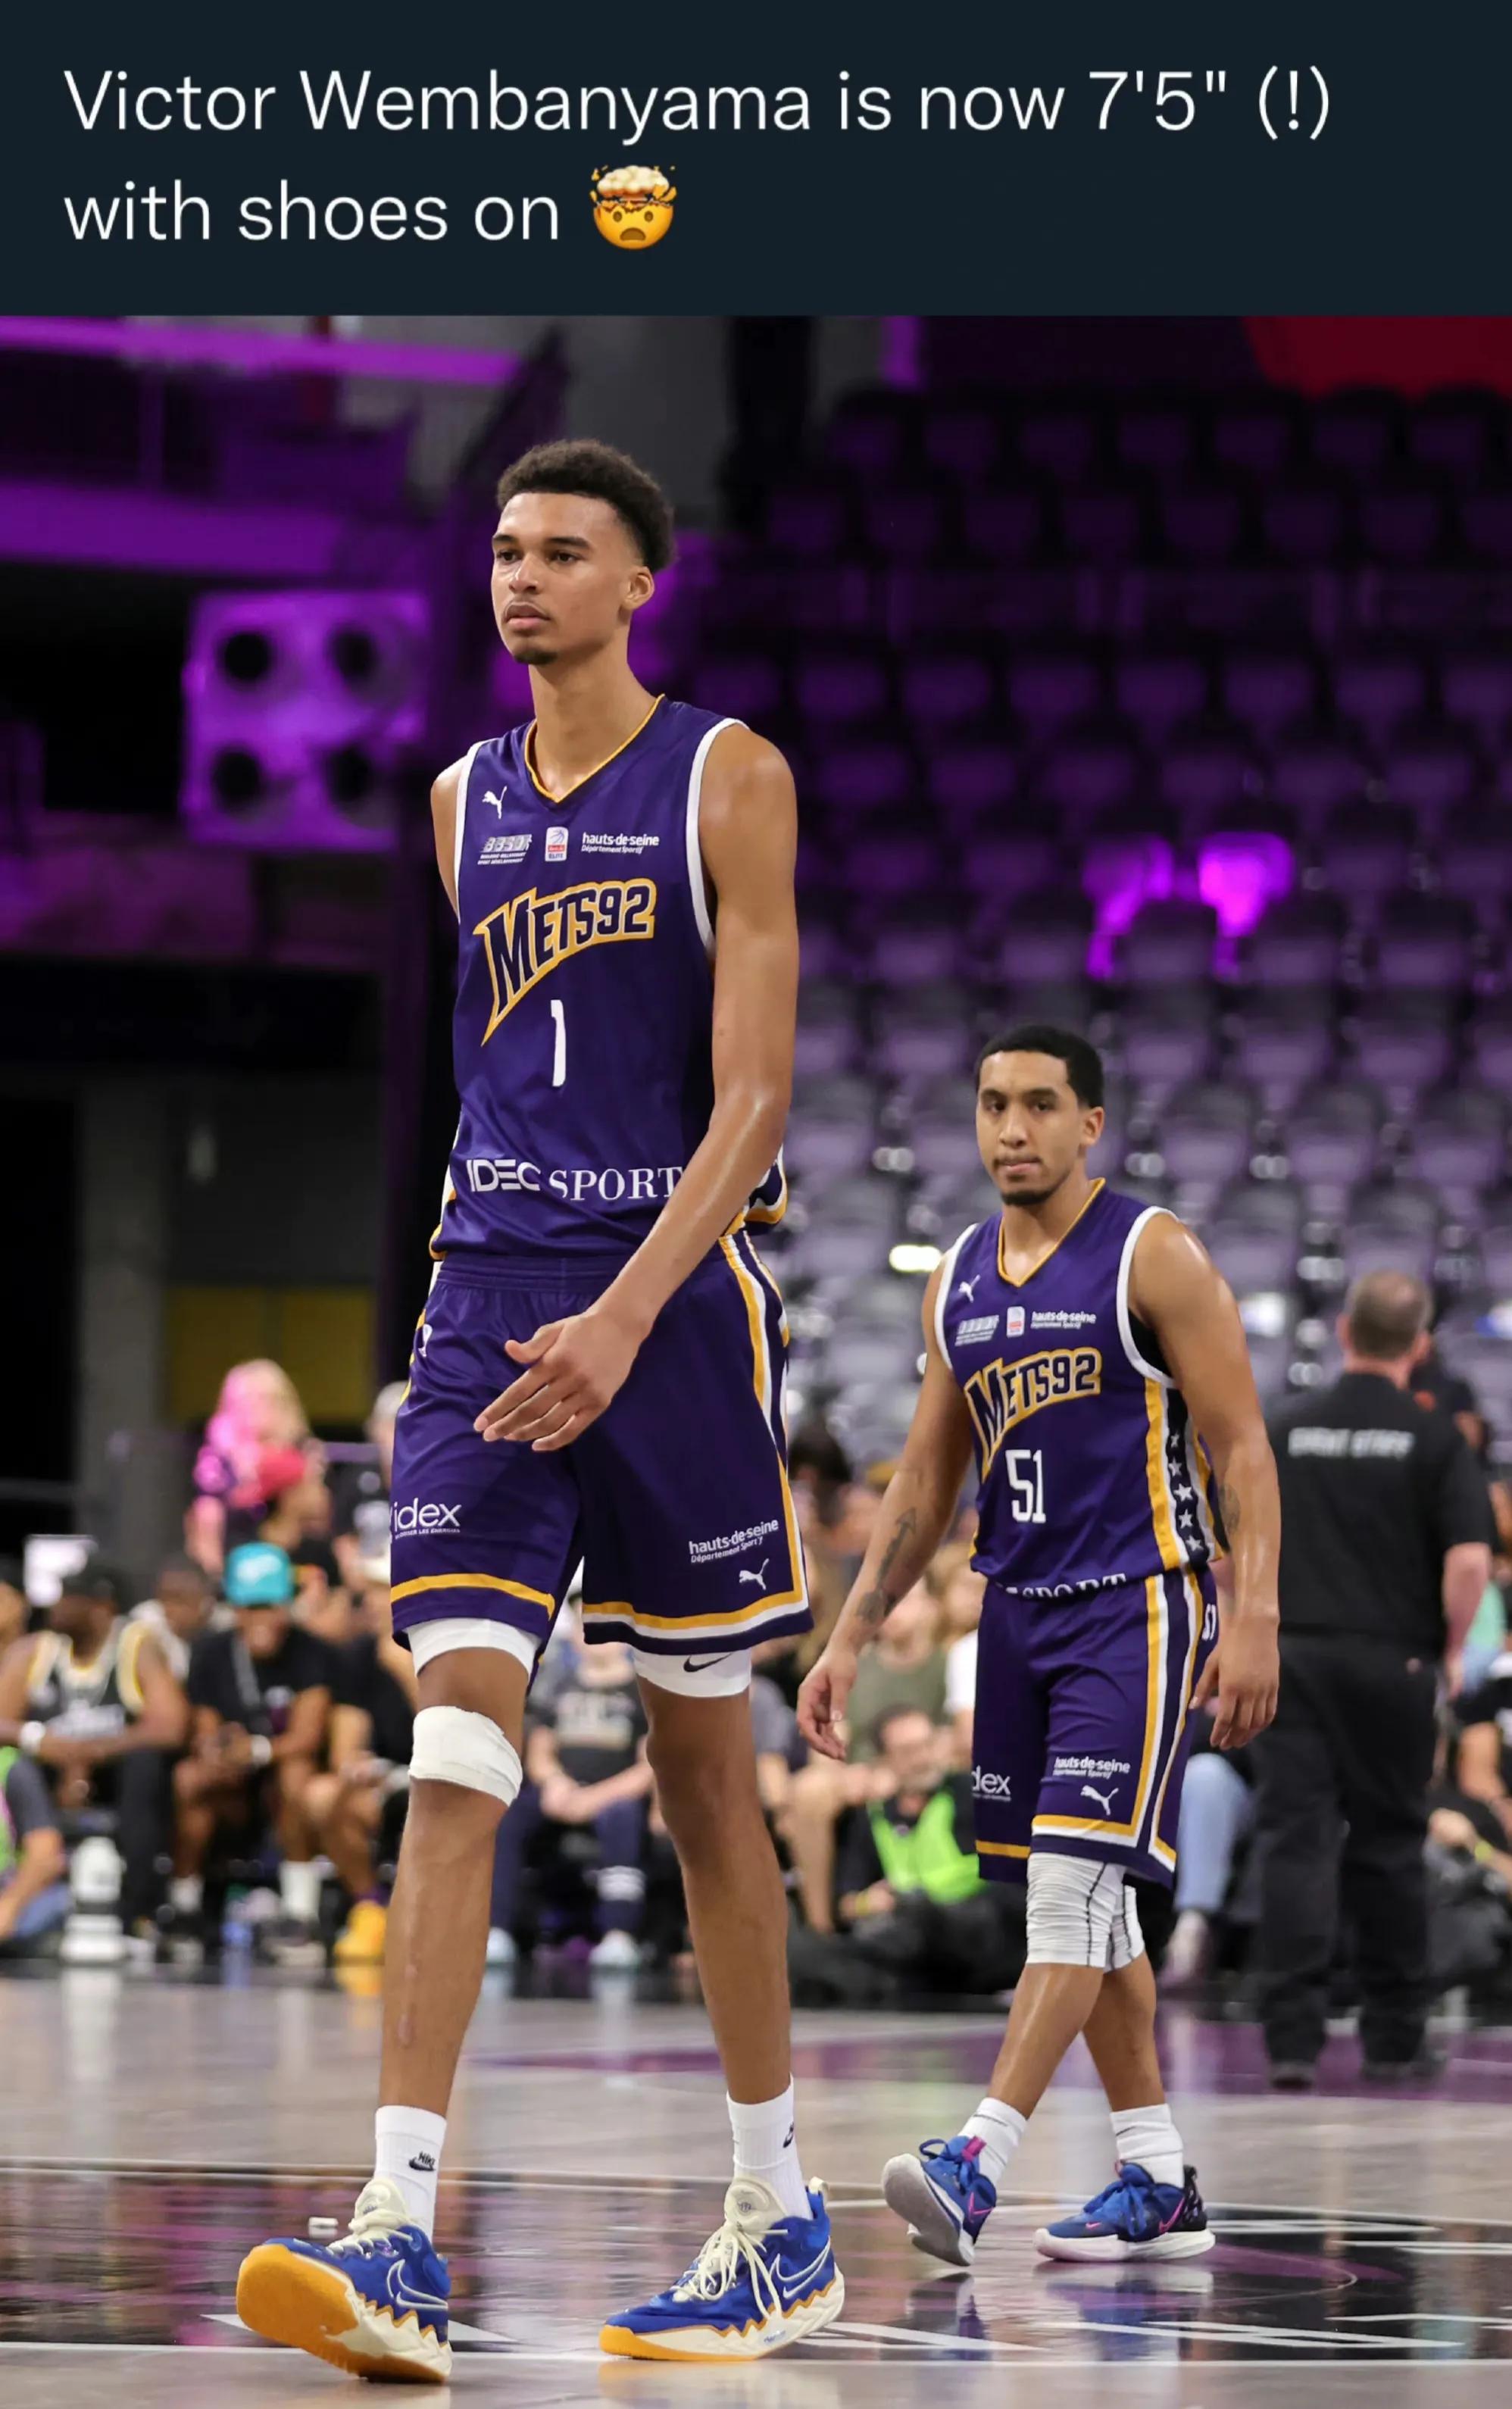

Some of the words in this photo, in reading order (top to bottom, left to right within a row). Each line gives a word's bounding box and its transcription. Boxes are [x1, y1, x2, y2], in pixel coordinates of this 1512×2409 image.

[551, 999, 567, 1087] 1
[467, 1159, 542, 1192] IDEC
[548, 1166, 683, 1201] SPORT
[1005, 1449, 1046, 1523] 51
[971, 1765, 1011, 1795] dex
